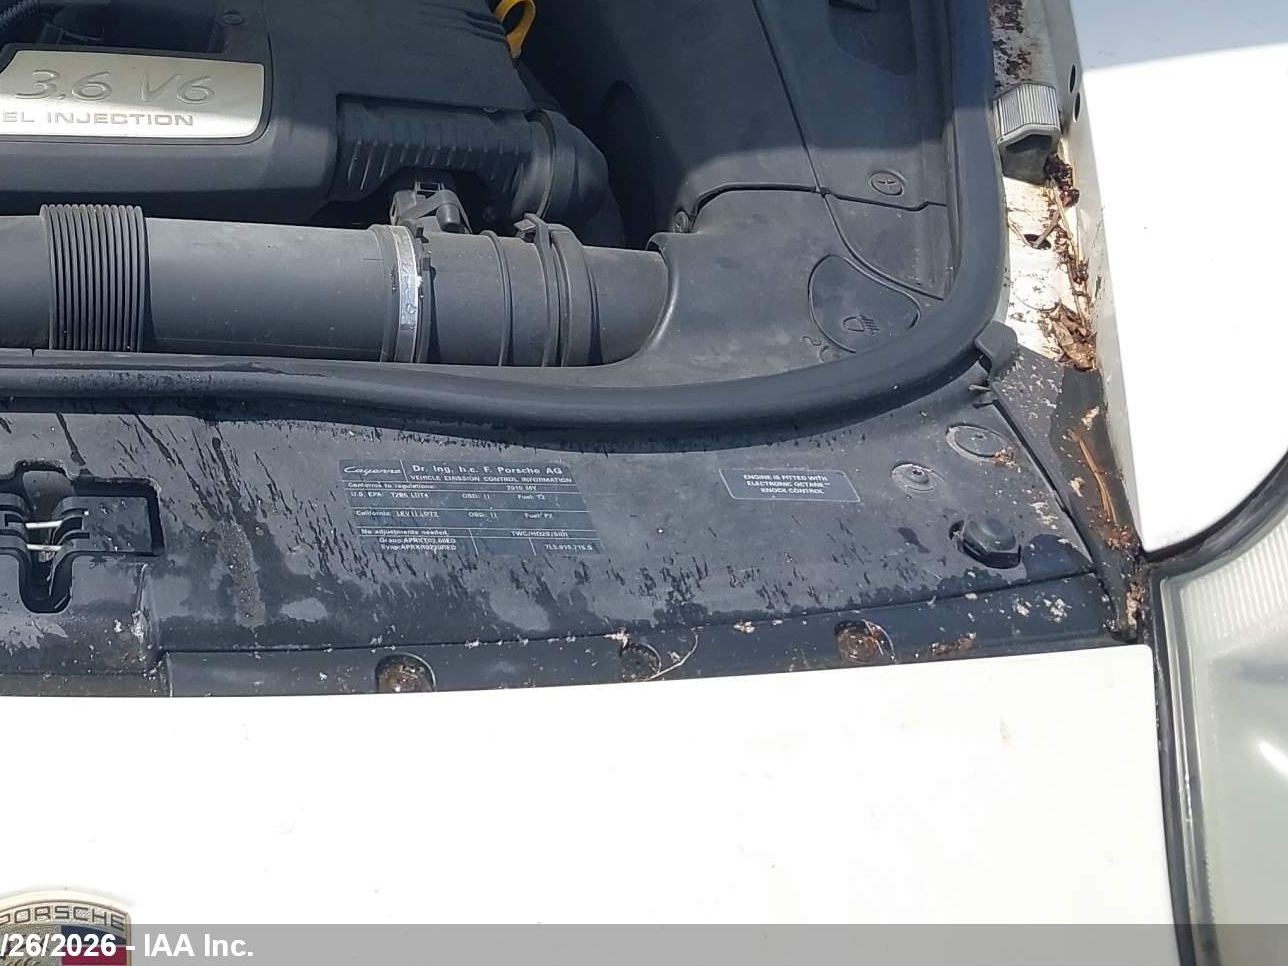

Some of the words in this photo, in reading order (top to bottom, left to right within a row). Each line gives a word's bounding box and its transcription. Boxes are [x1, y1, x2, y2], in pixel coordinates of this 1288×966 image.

[141, 72, 216, 105] V6
[47, 112, 194, 127] INJECTION
[344, 467, 401, 475] Cayenne
[433, 466, 453, 474] Ing.
